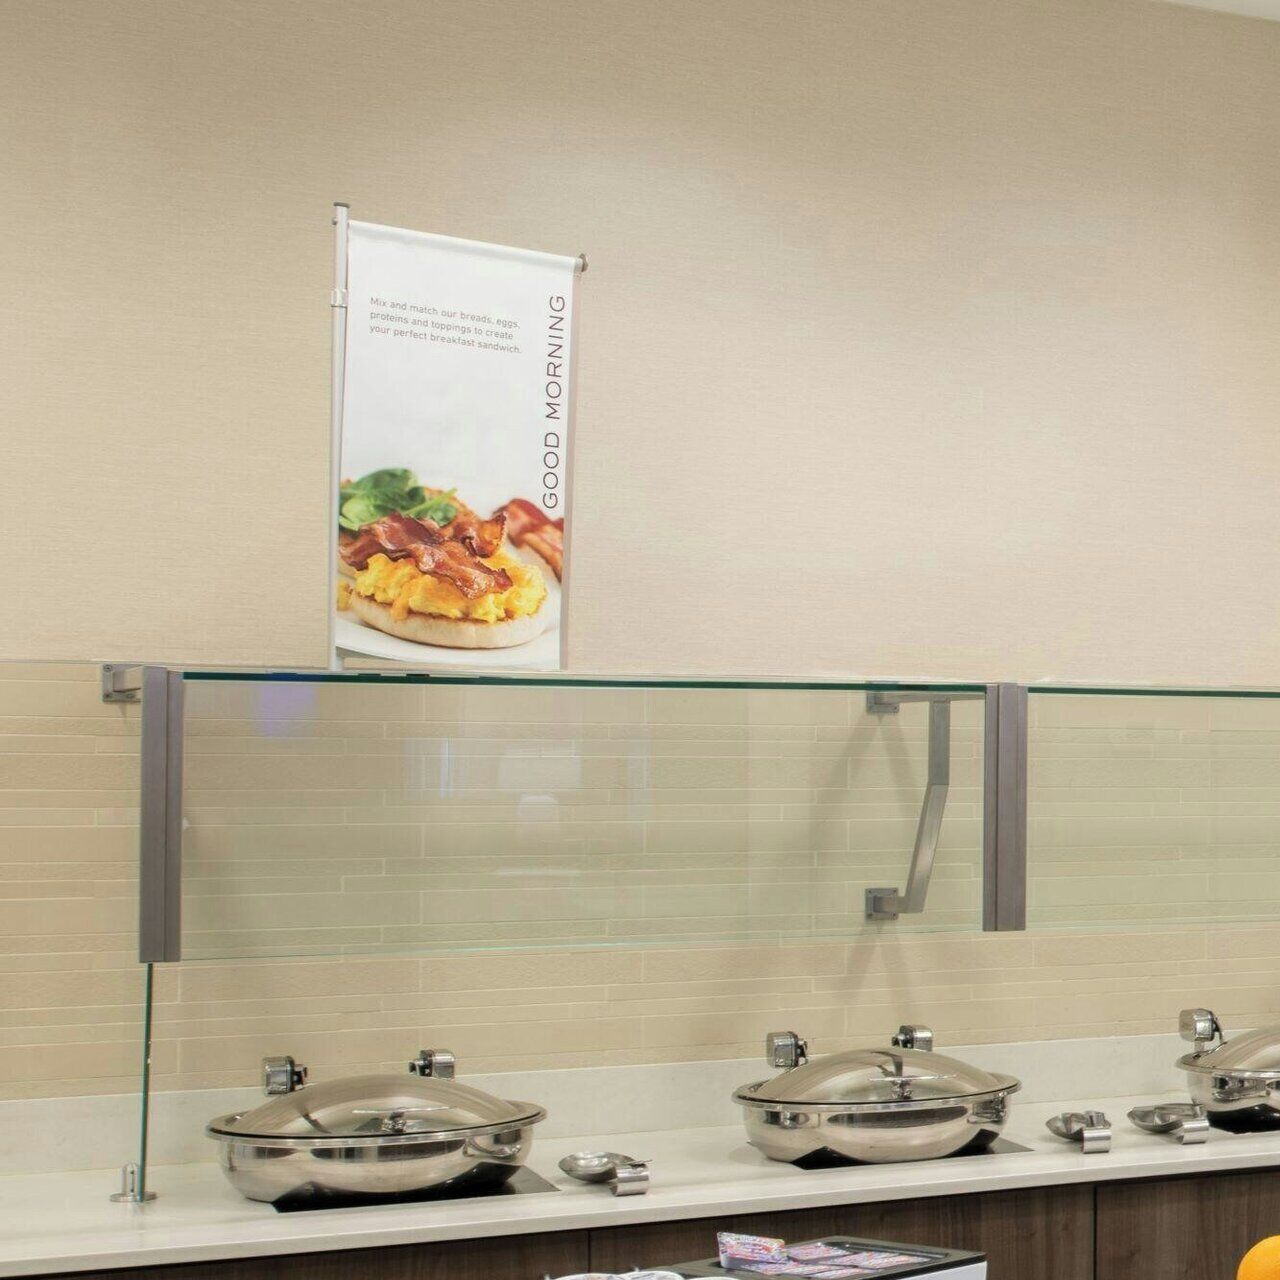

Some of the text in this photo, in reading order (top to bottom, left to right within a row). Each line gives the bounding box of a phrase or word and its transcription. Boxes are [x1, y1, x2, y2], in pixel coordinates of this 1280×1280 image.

[370, 297, 386, 307] Mix
[390, 301, 407, 310] and
[409, 303, 438, 315] match
[441, 309, 457, 318] our
[496, 318, 521, 329] eggs,
[370, 311, 514, 340] proteins and toppings to create
[369, 325, 522, 354] your perfect breakfast sandwich.
[543, 296, 566, 509] GOOD MORNING
